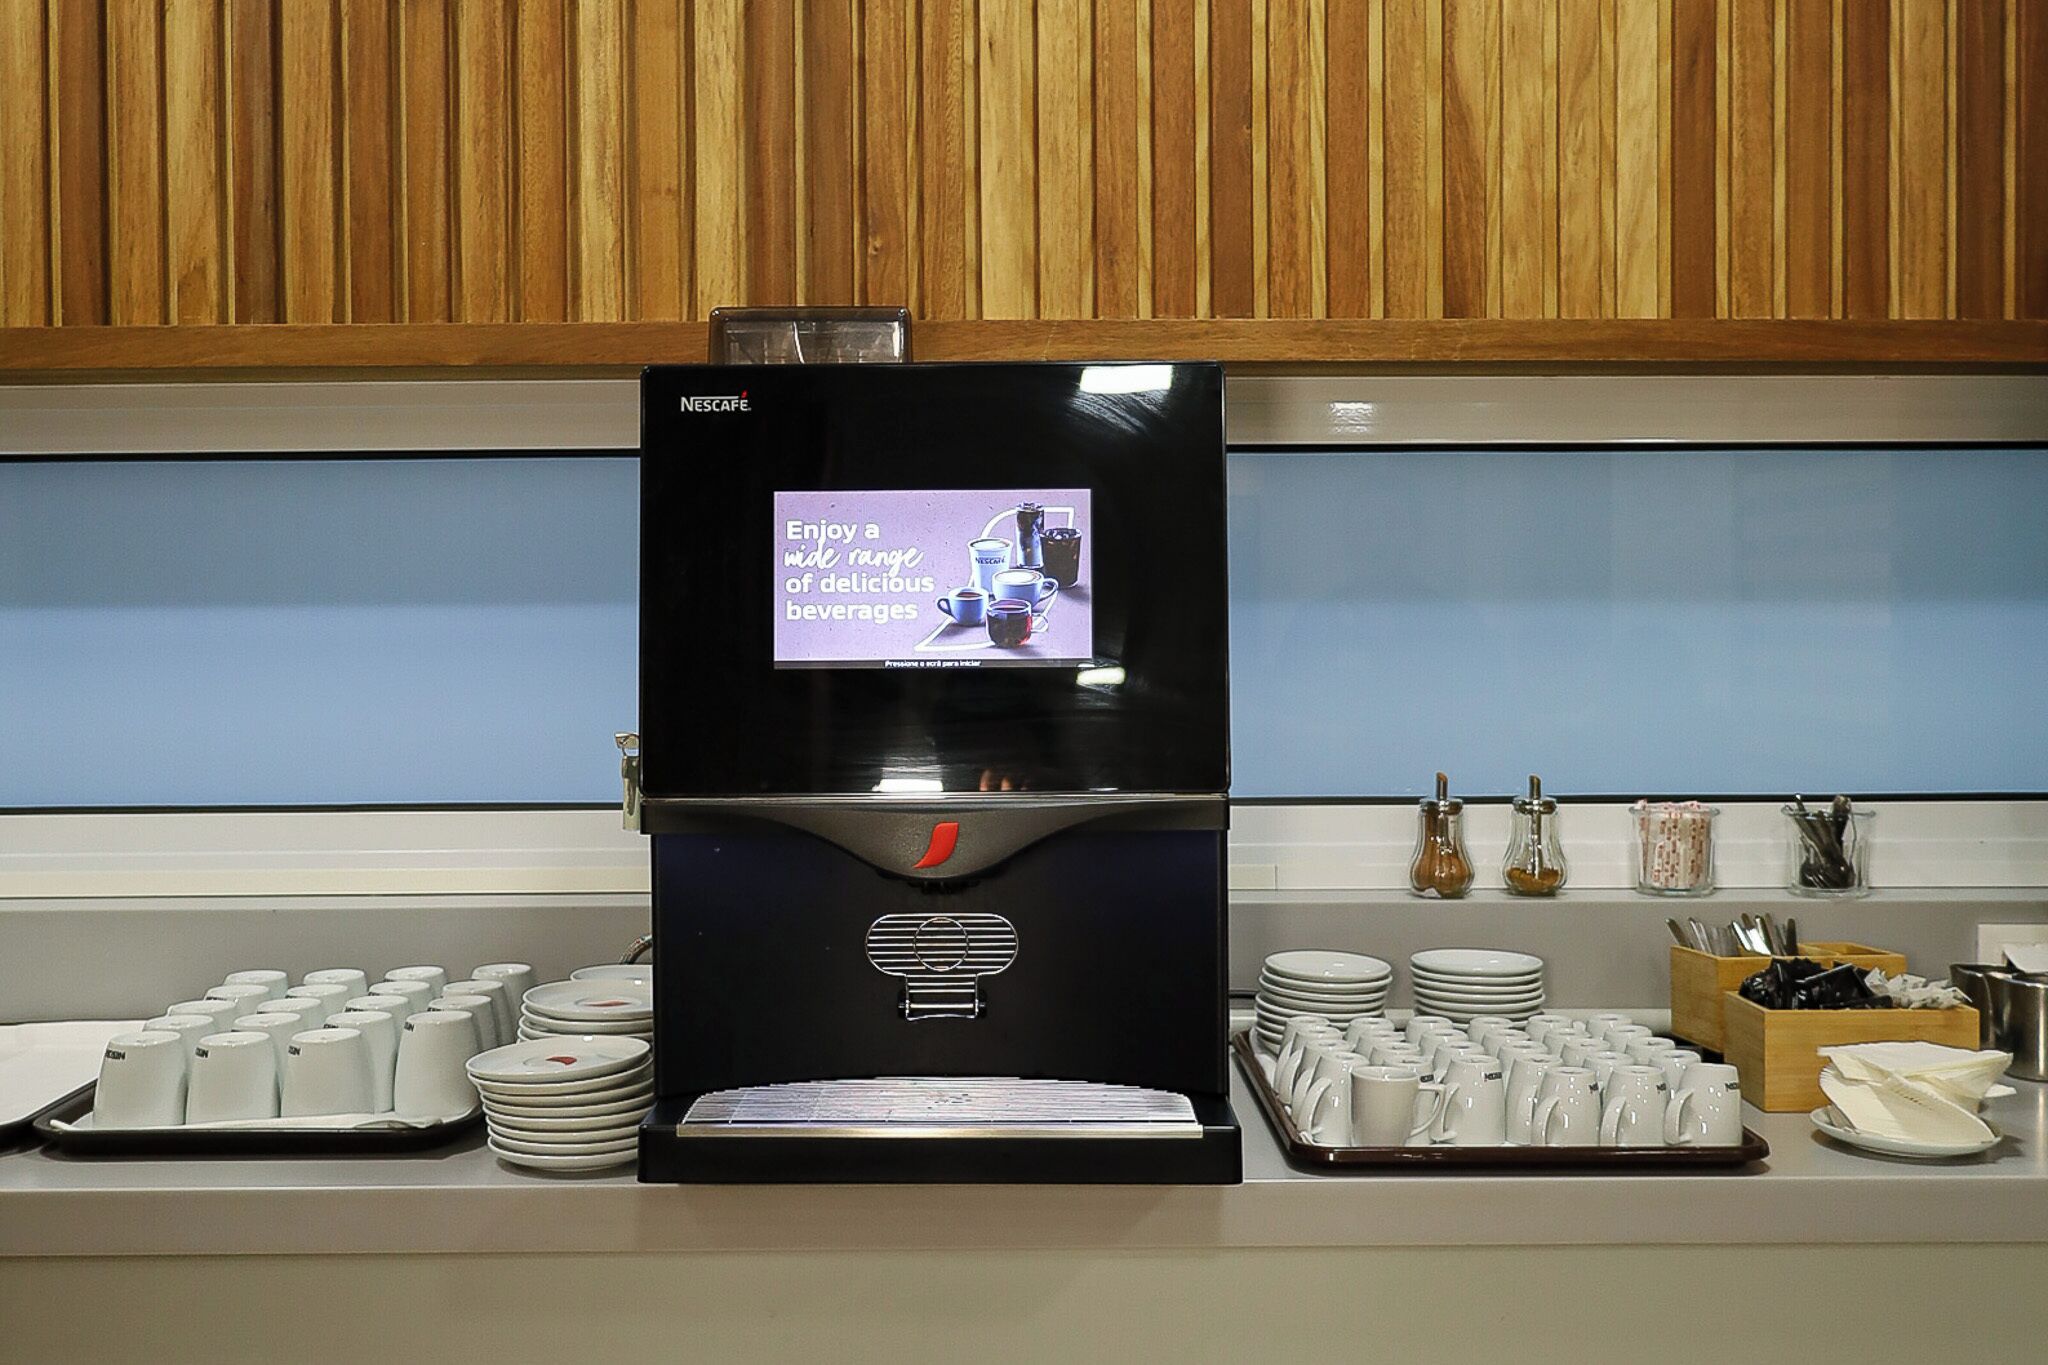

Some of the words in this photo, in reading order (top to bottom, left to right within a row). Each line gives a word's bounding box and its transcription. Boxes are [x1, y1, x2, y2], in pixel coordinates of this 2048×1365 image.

[786, 519, 857, 544] Enjoy
[864, 522, 880, 539] a
[784, 543, 842, 569] wide
[848, 547, 924, 578] range
[785, 572, 813, 593] of
[820, 572, 936, 593] delicious
[786, 600, 919, 625] beverages
